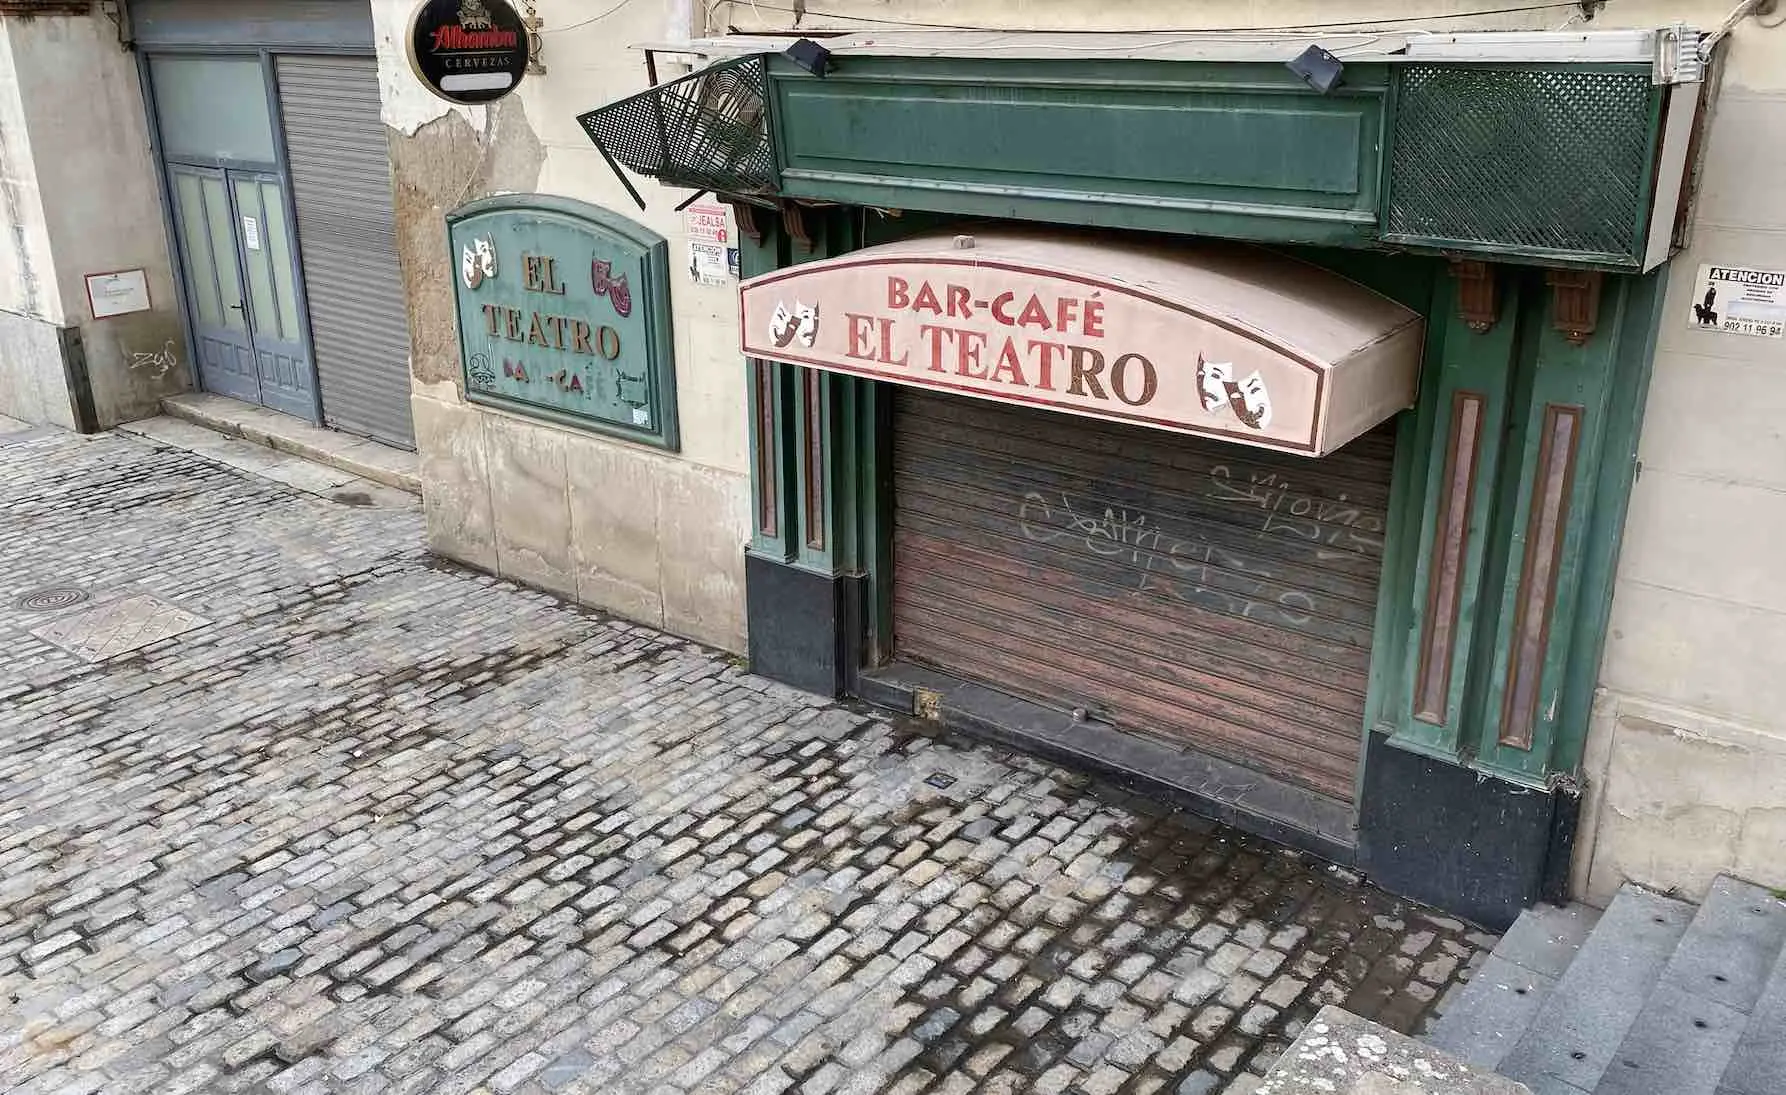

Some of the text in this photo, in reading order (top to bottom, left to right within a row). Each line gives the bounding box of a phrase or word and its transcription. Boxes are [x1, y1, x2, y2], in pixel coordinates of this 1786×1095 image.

[444, 55, 513, 70] CERVEZAS
[522, 252, 566, 296] EL
[1710, 268, 1784, 286] ATENCION
[481, 303, 621, 362] TEATRO
[887, 275, 1105, 339] BAR-CAFÉ
[844, 312, 1160, 407] EL TEATRO
